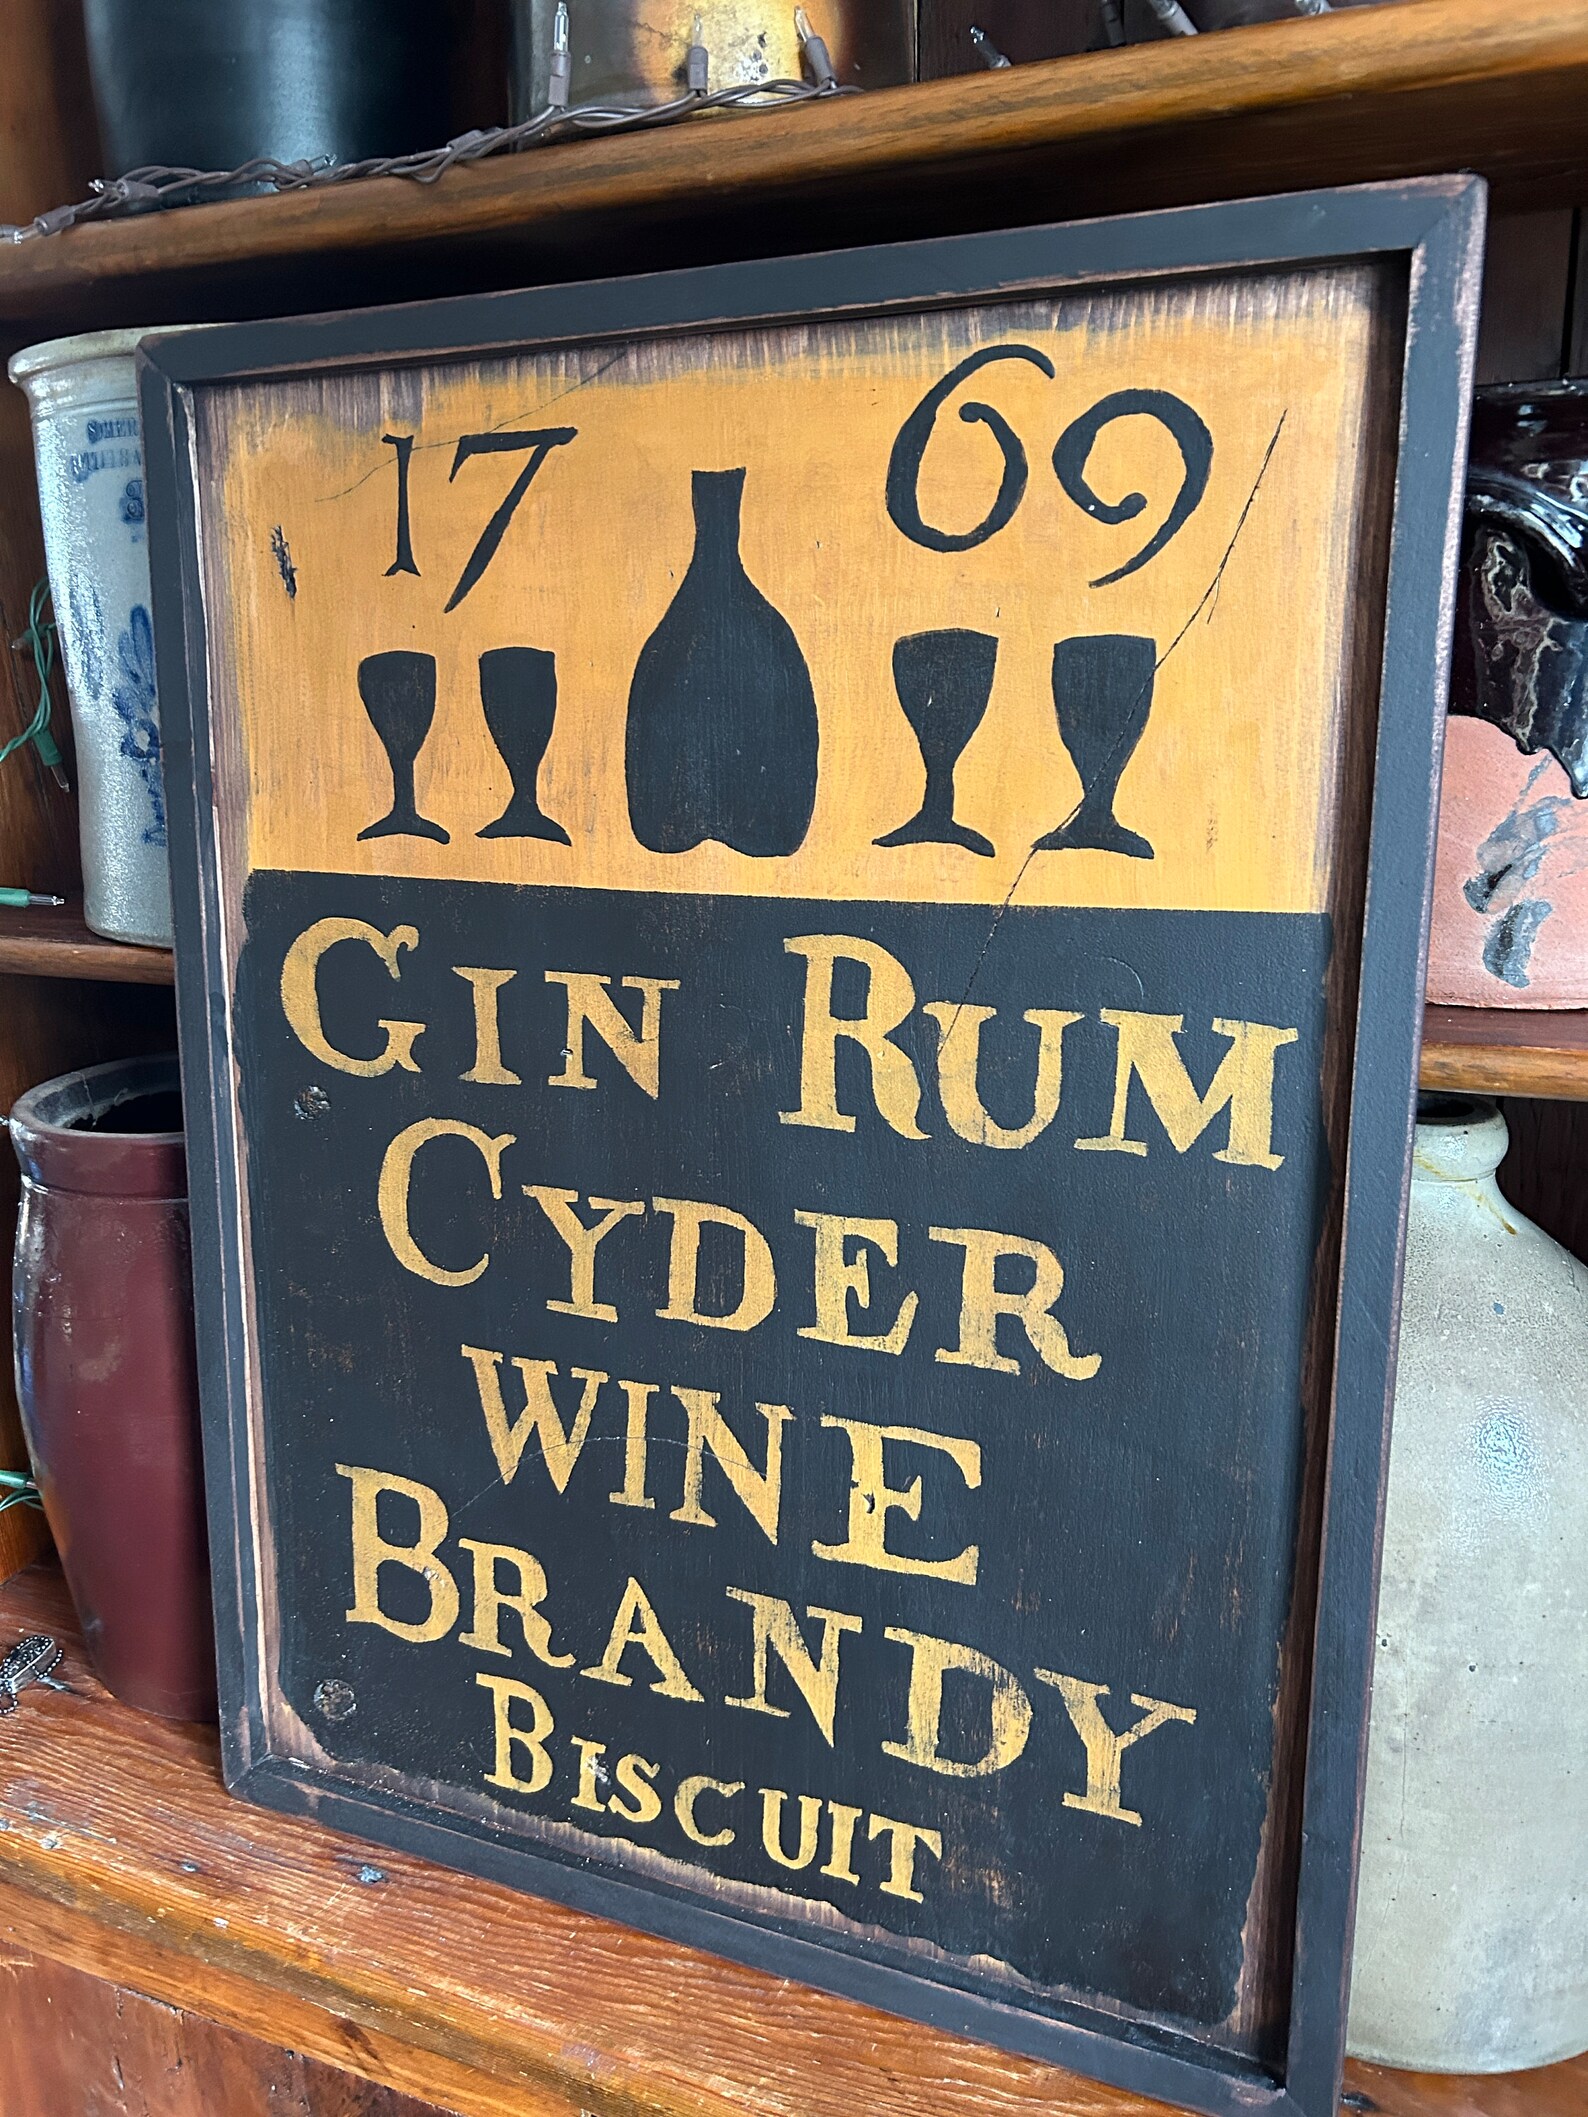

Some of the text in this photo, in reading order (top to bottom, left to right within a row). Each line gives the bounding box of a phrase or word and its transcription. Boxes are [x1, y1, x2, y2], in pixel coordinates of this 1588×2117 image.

[381, 343, 1214, 613] 17 69
[281, 917, 1298, 1169] GIN RUM
[377, 1118, 1101, 1380] CYDER
[461, 1344, 982, 1586] WINE
[334, 1463, 1197, 1827] BRANDY
[475, 1673, 943, 1904] BISCUIT
